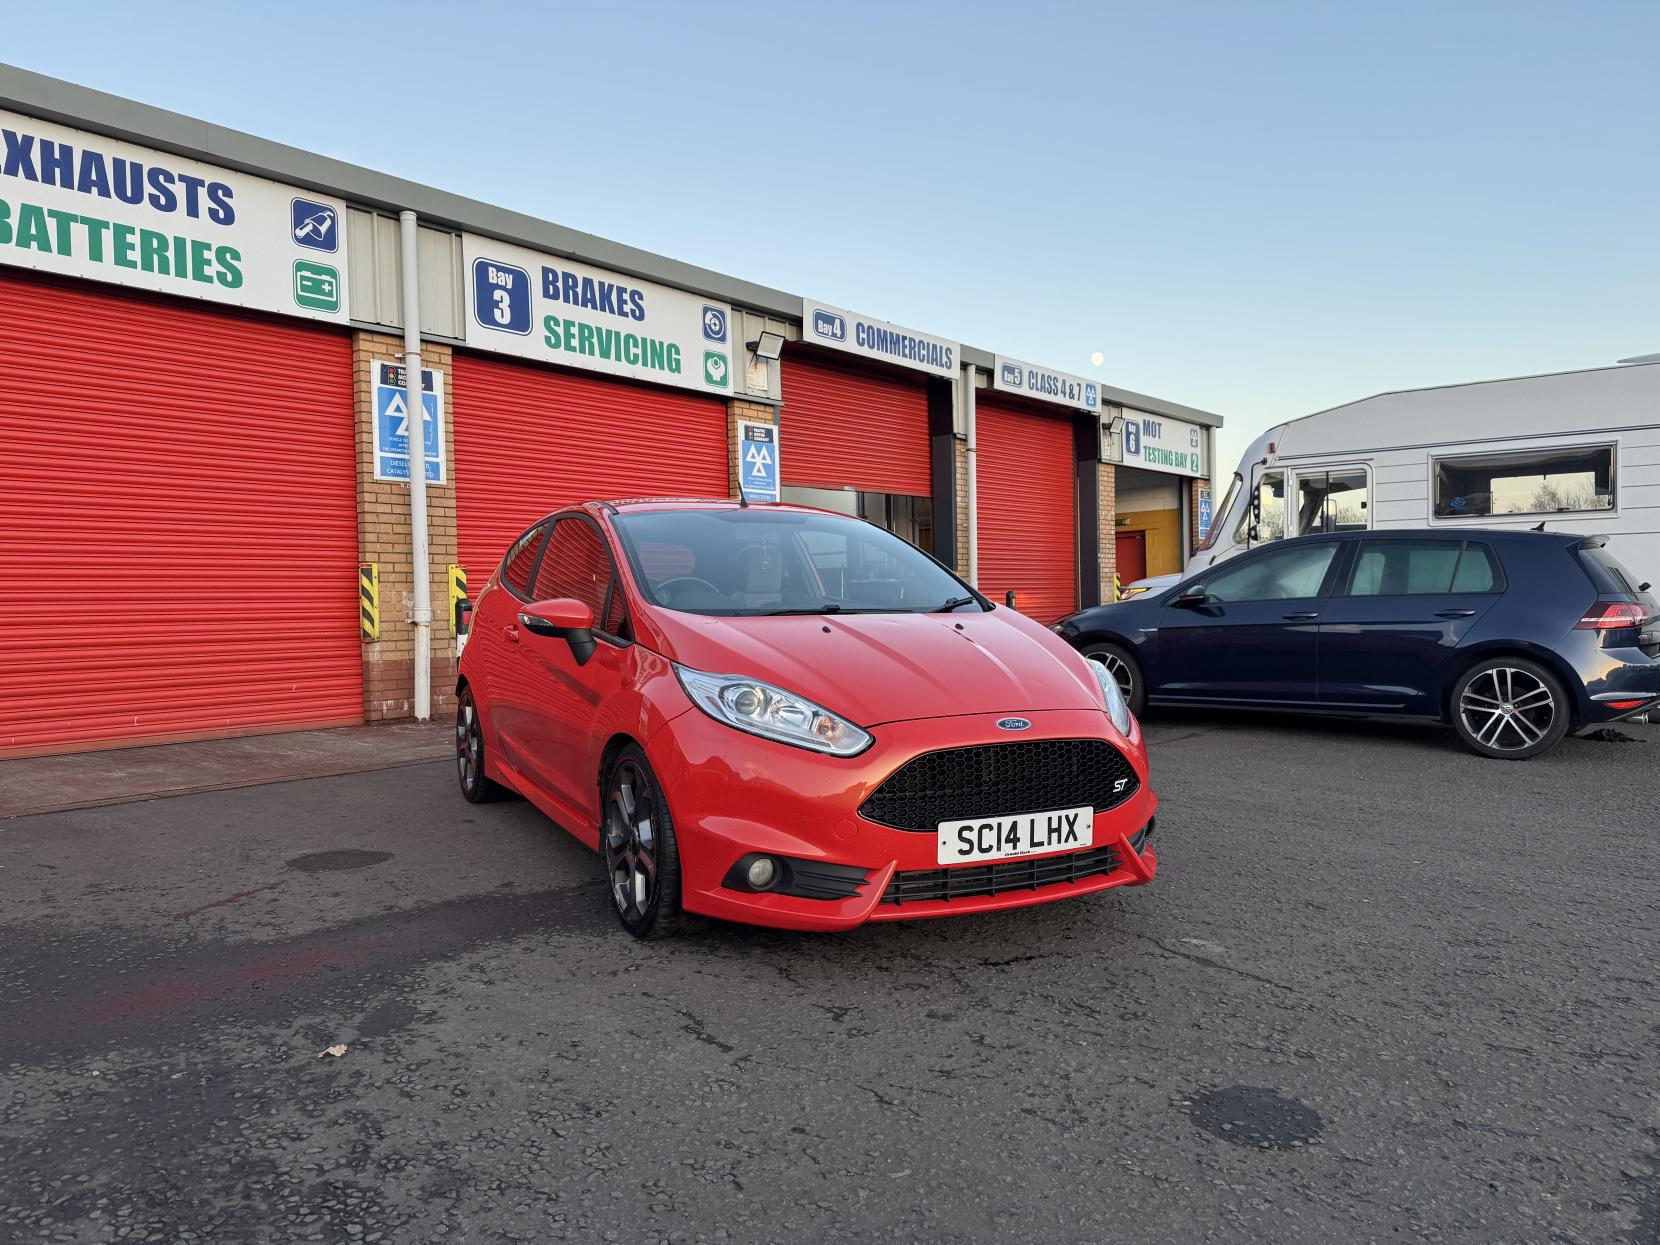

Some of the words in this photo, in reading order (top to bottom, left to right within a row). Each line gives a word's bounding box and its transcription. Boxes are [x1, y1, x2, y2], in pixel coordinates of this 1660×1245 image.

[0, 128, 236, 226] XHAUSTS
[488, 266, 513, 289] Bay
[541, 265, 646, 322] BRAKES
[493, 289, 511, 325] 3
[817, 319, 833, 337] Bay
[833, 318, 842, 338] 4
[543, 314, 682, 375] SERVICING
[855, 321, 953, 370] COMMERCIALS
[1014, 368, 1021, 385] 5
[1028, 369, 1058, 396] CLASS
[1060, 378, 1067, 398] 4
[1068, 383, 1075, 400] &
[1076, 382, 1082, 401] 7
[1142, 418, 1162, 439] MOT
[1129, 433, 1136, 453] 6
[1143, 445, 1173, 466] TESTING
[1174, 451, 1188, 468] BAY
[1191, 454, 1198, 471] 2
[1005, 719, 1024, 728] Ford
[1112, 778, 1128, 793] ST
[957, 820, 1020, 856] SC14
[1029, 813, 1079, 849] LHX
